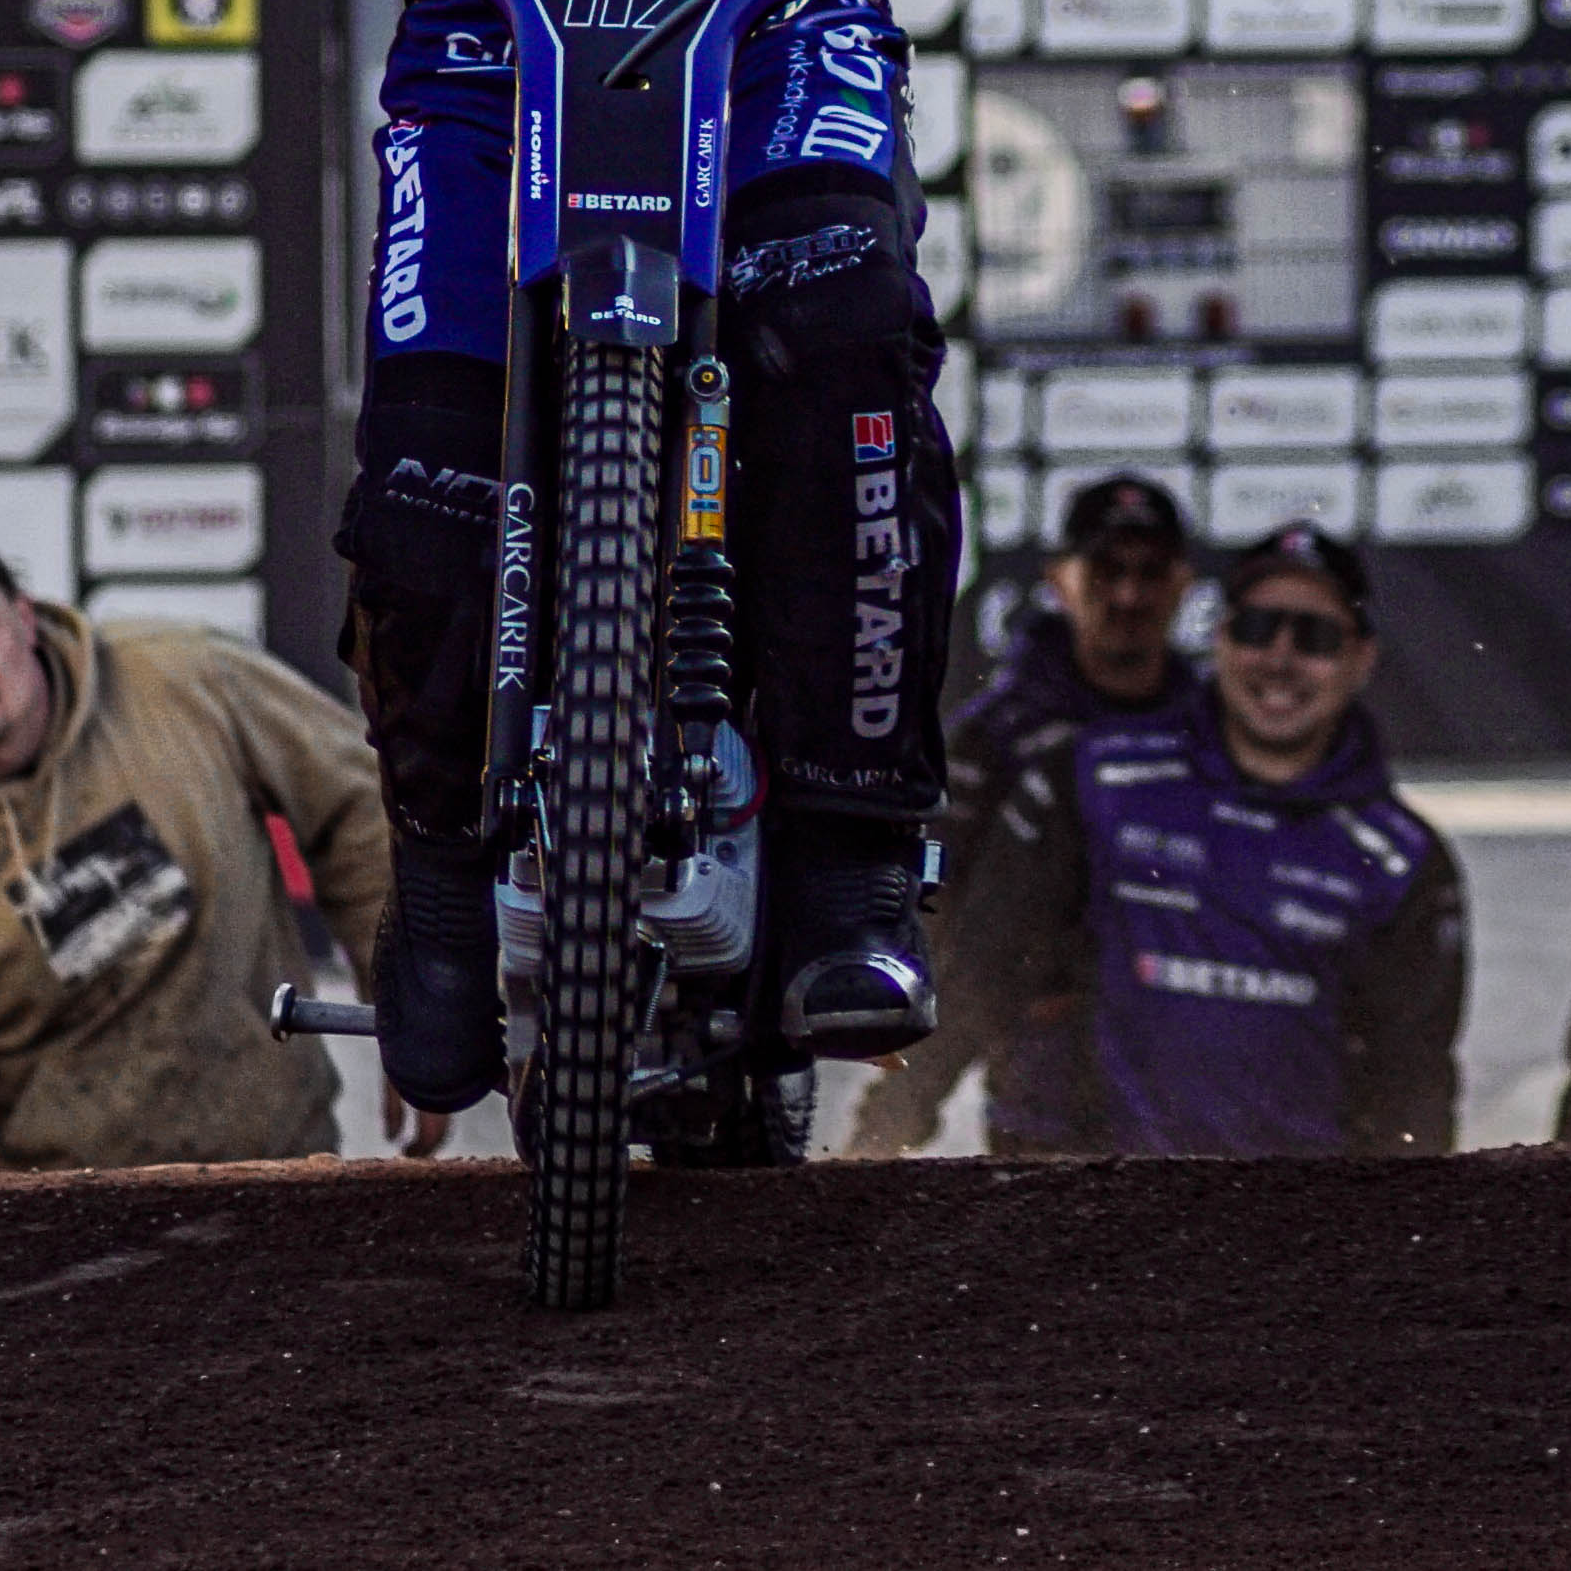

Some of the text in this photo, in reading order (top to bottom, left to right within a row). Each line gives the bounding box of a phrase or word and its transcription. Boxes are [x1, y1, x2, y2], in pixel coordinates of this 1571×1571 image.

[383, 144, 428, 344] BETARD
[586, 193, 672, 212] BETARD
[590, 308, 662, 326] BETARD
[497, 482, 535, 691] GARCAREK
[851, 469, 903, 739] BETARD
